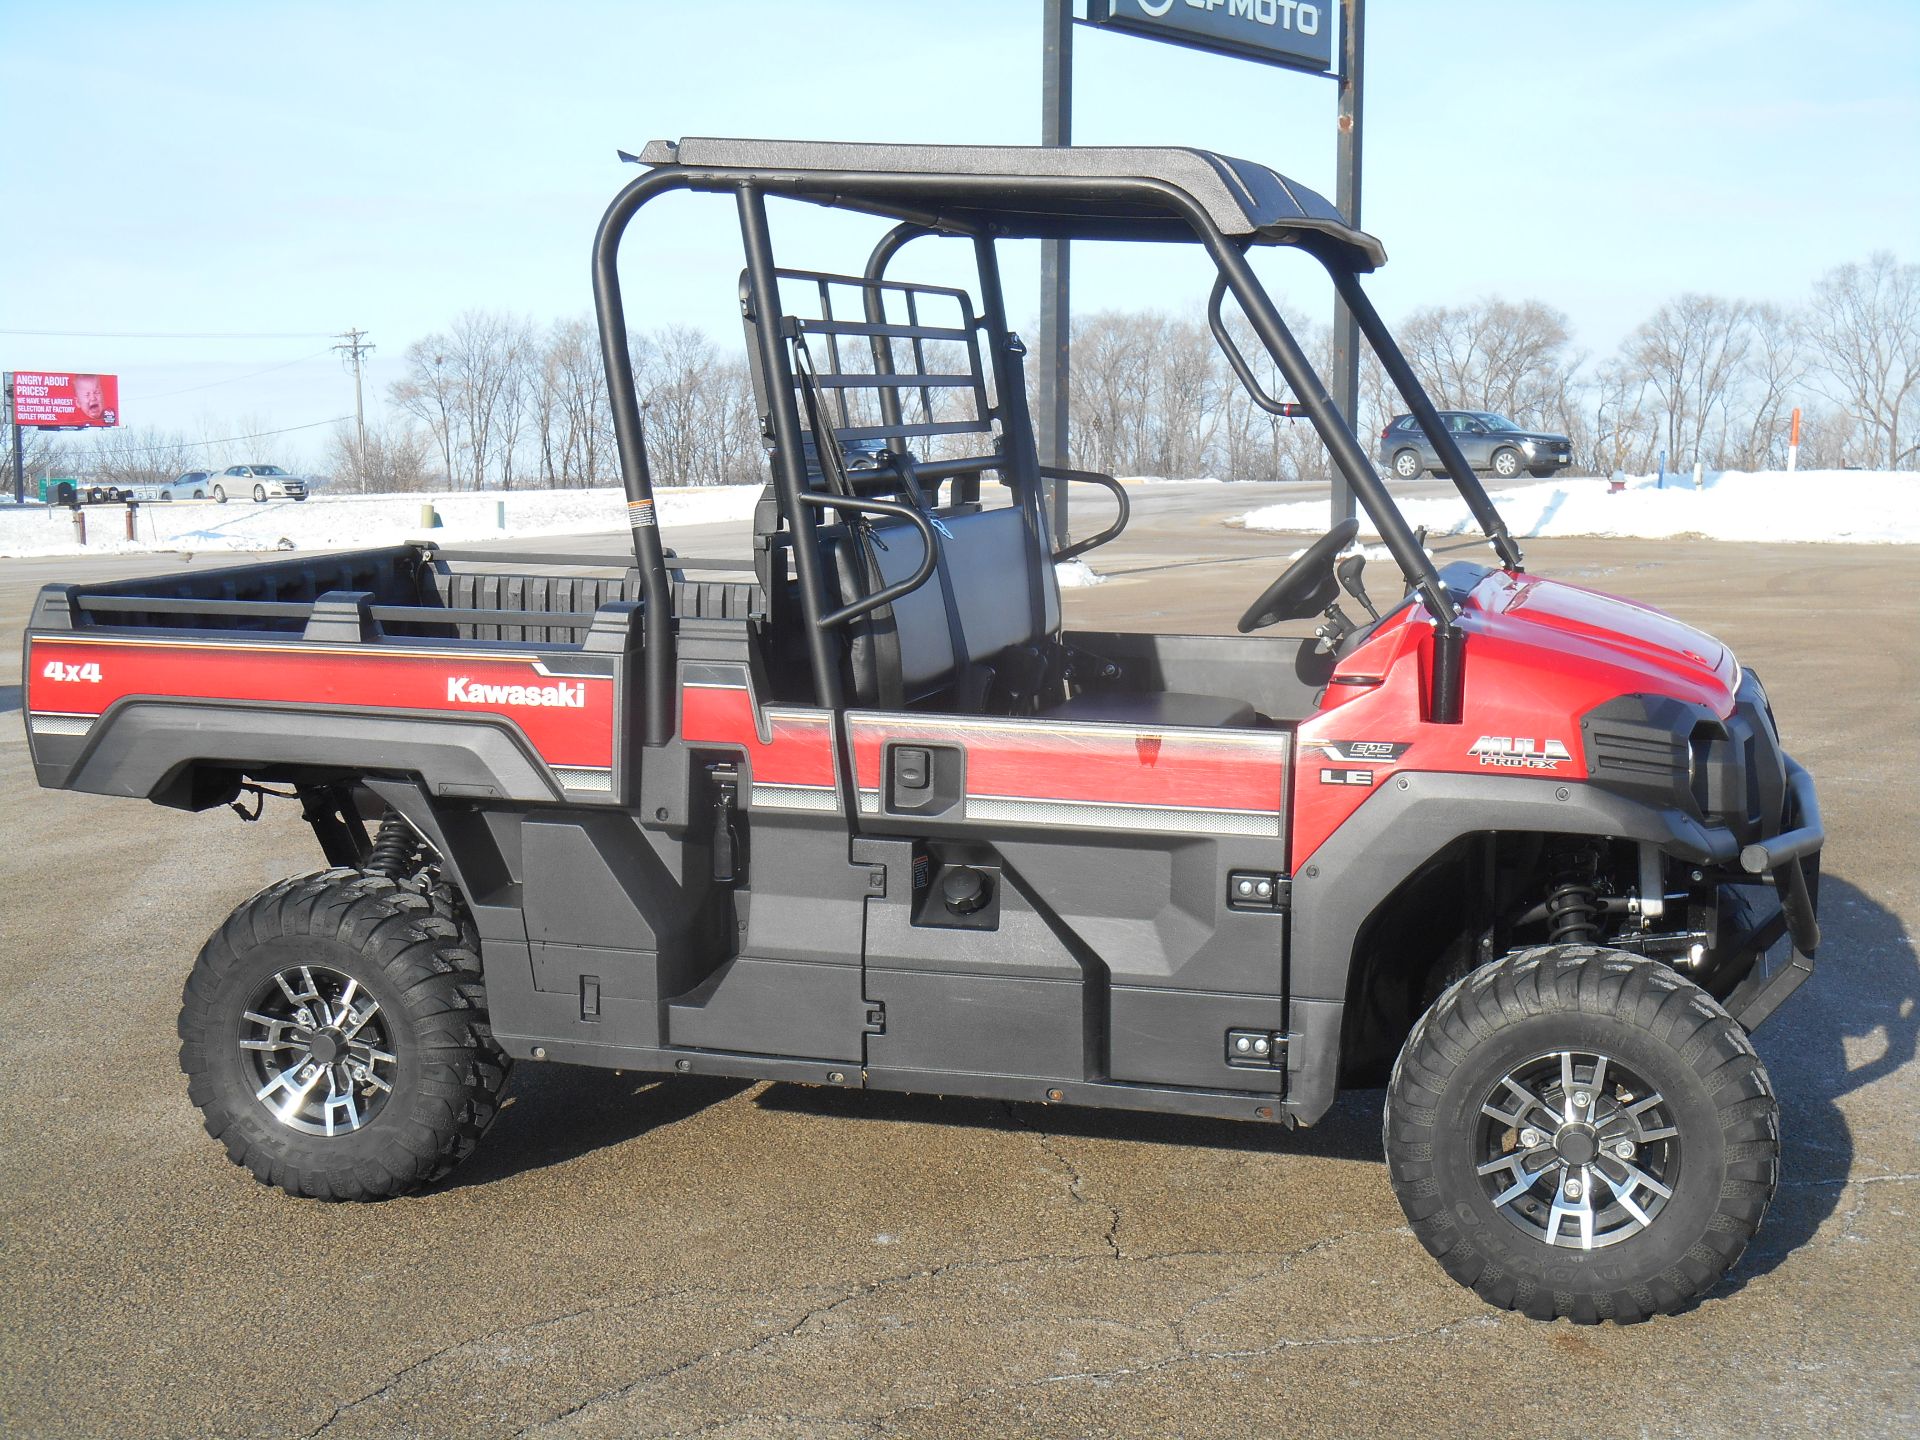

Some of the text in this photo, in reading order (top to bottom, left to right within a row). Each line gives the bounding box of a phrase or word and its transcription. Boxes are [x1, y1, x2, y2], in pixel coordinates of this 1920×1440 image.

[1184, 0, 1319, 36] MOTO
[16, 375, 69, 386] ANGRY ABOUT
[16, 386, 48, 396] PRICES?
[17, 405, 45, 413] SELECTION
[53, 406, 75, 414] FACTORY
[43, 661, 102, 683] 4x4
[447, 677, 585, 708] Kawasaki
[1321, 769, 1372, 785] LE
